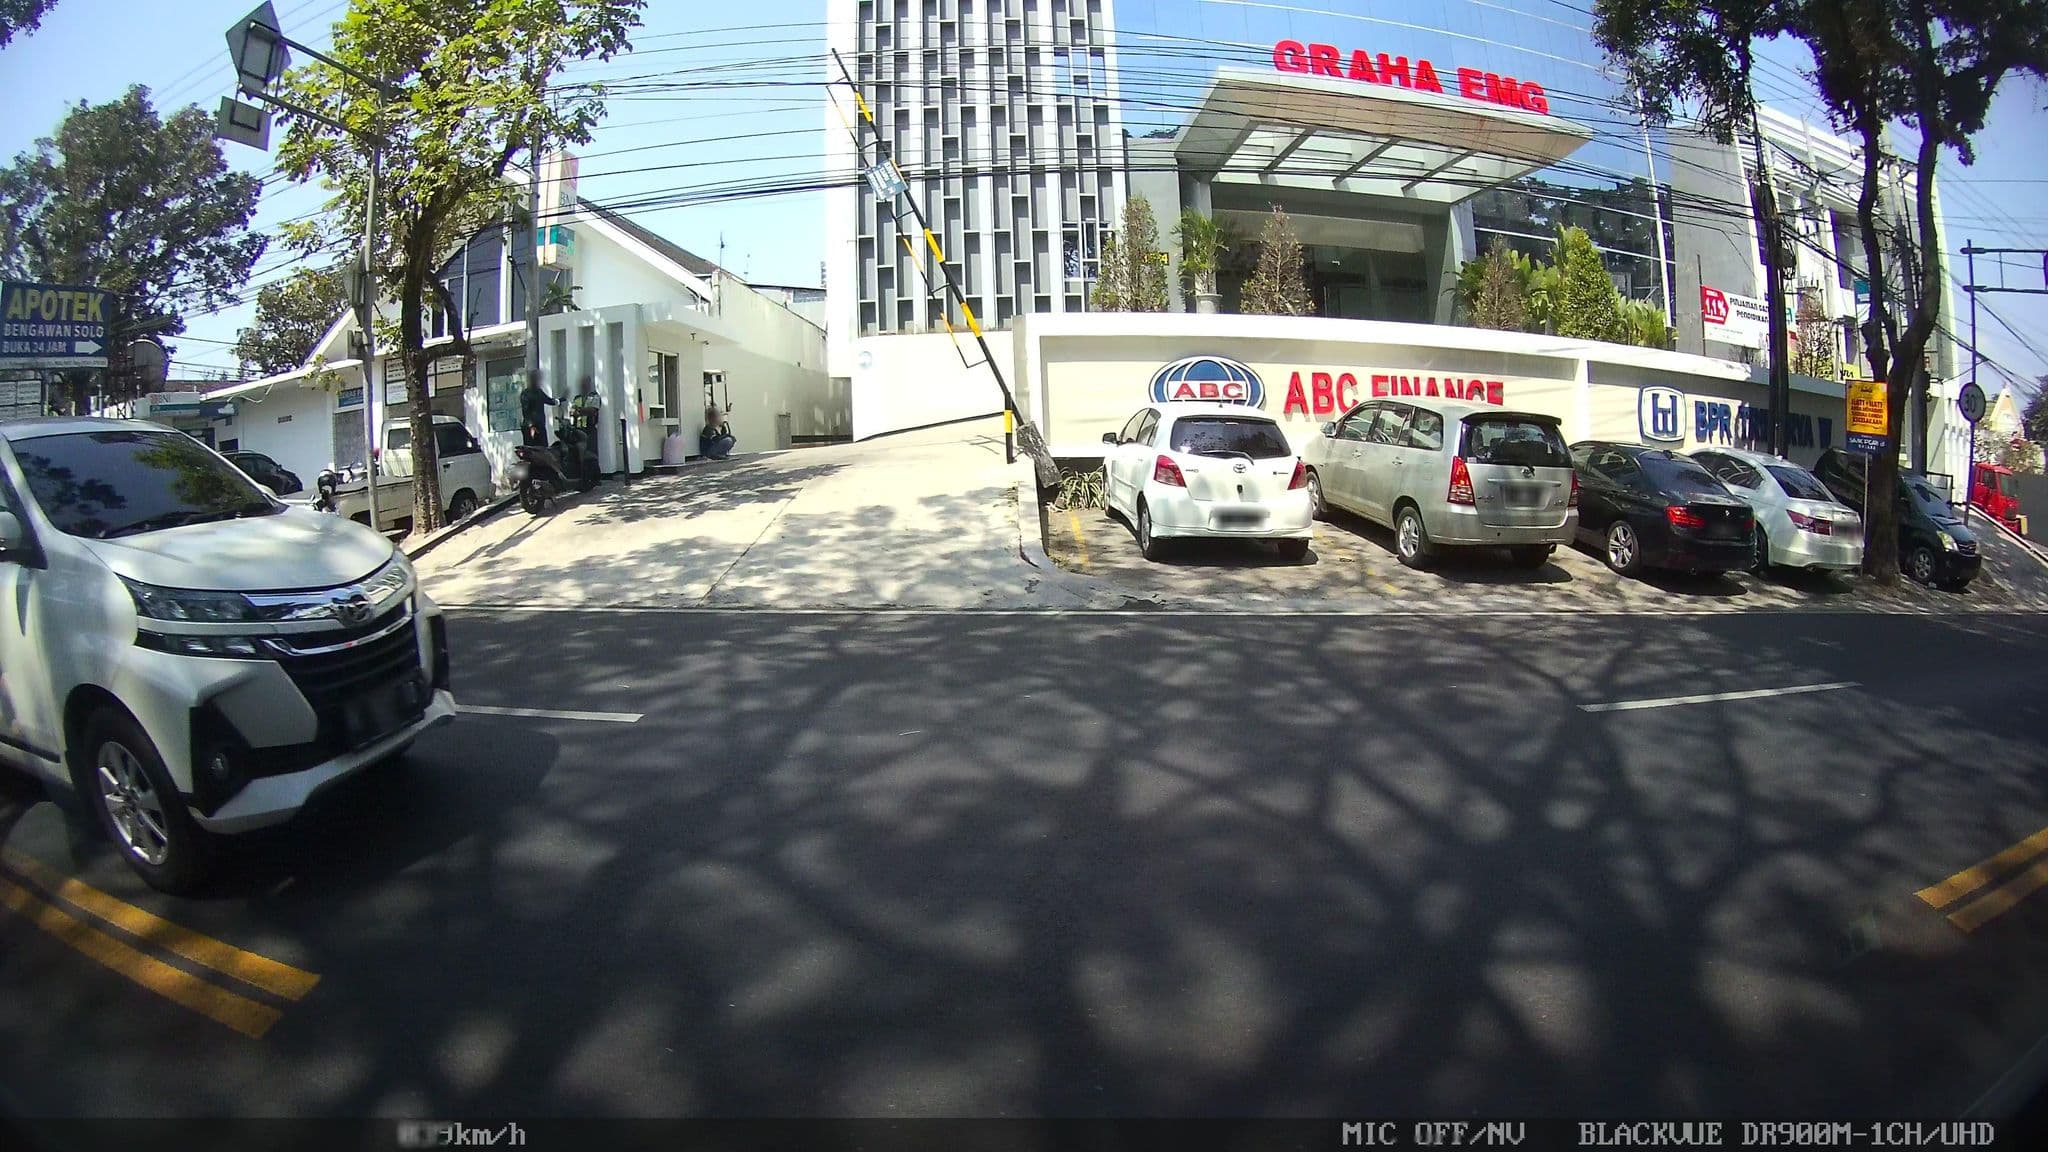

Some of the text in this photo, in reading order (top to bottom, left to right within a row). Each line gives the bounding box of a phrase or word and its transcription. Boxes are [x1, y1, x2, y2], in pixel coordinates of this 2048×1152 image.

[1273, 38, 1549, 116] GRAHA EMG
[6, 288, 105, 322] APOTEK
[1, 341, 67, 353] BUKA 24 JAM
[4, 323, 104, 338] BENGAWAN SOLO
[1173, 383, 1244, 399] ABC
[1283, 372, 1360, 415] ABC
[1695, 400, 1734, 446] BPR
